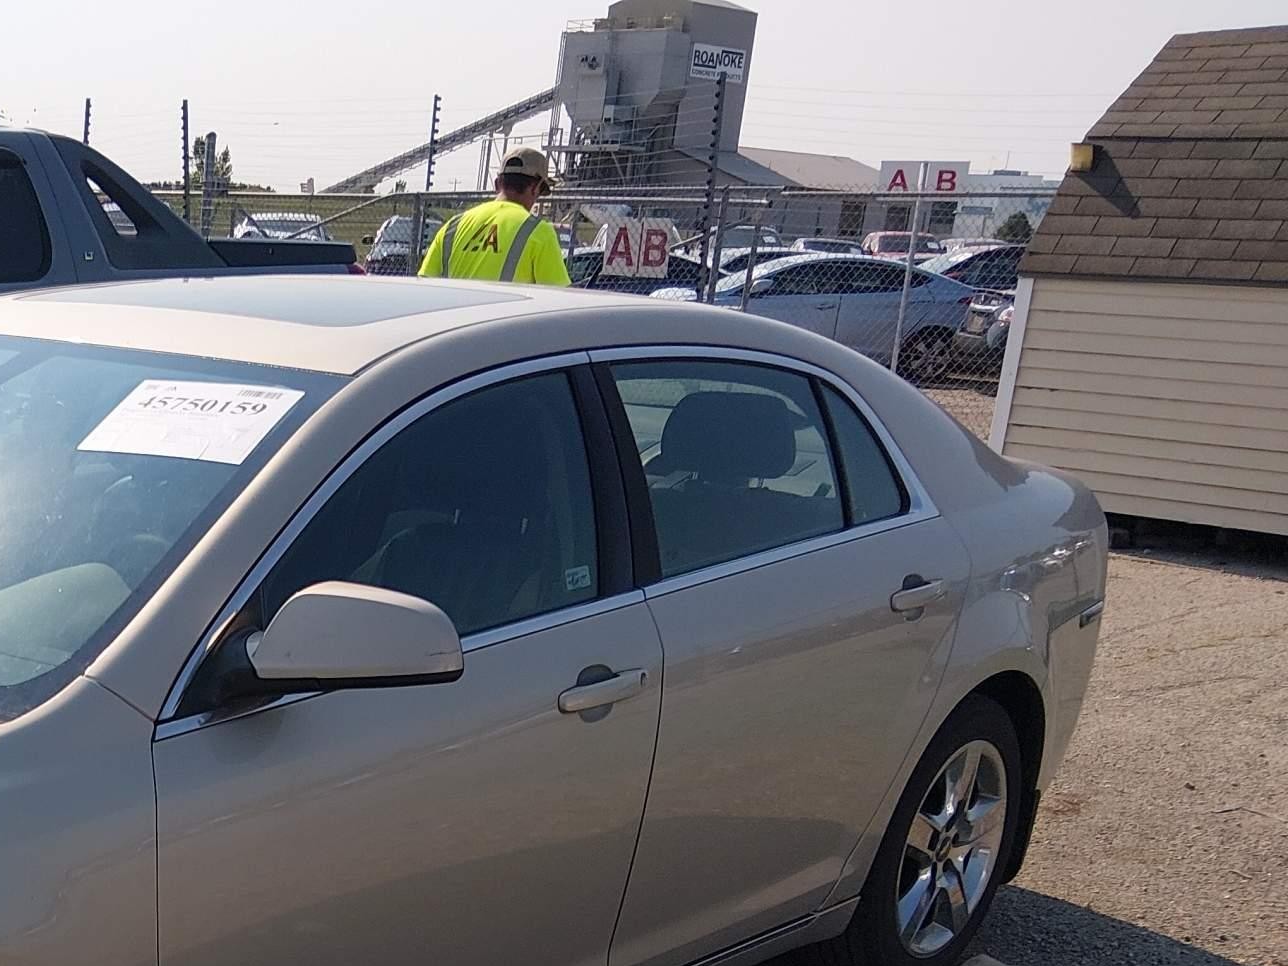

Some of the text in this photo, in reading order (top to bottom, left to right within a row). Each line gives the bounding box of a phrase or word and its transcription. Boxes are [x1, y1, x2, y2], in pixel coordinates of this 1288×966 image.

[693, 49, 744, 69] ROANOKE
[887, 169, 958, 192] A B
[606, 226, 669, 268] A B
[138, 395, 268, 417] 45750159
